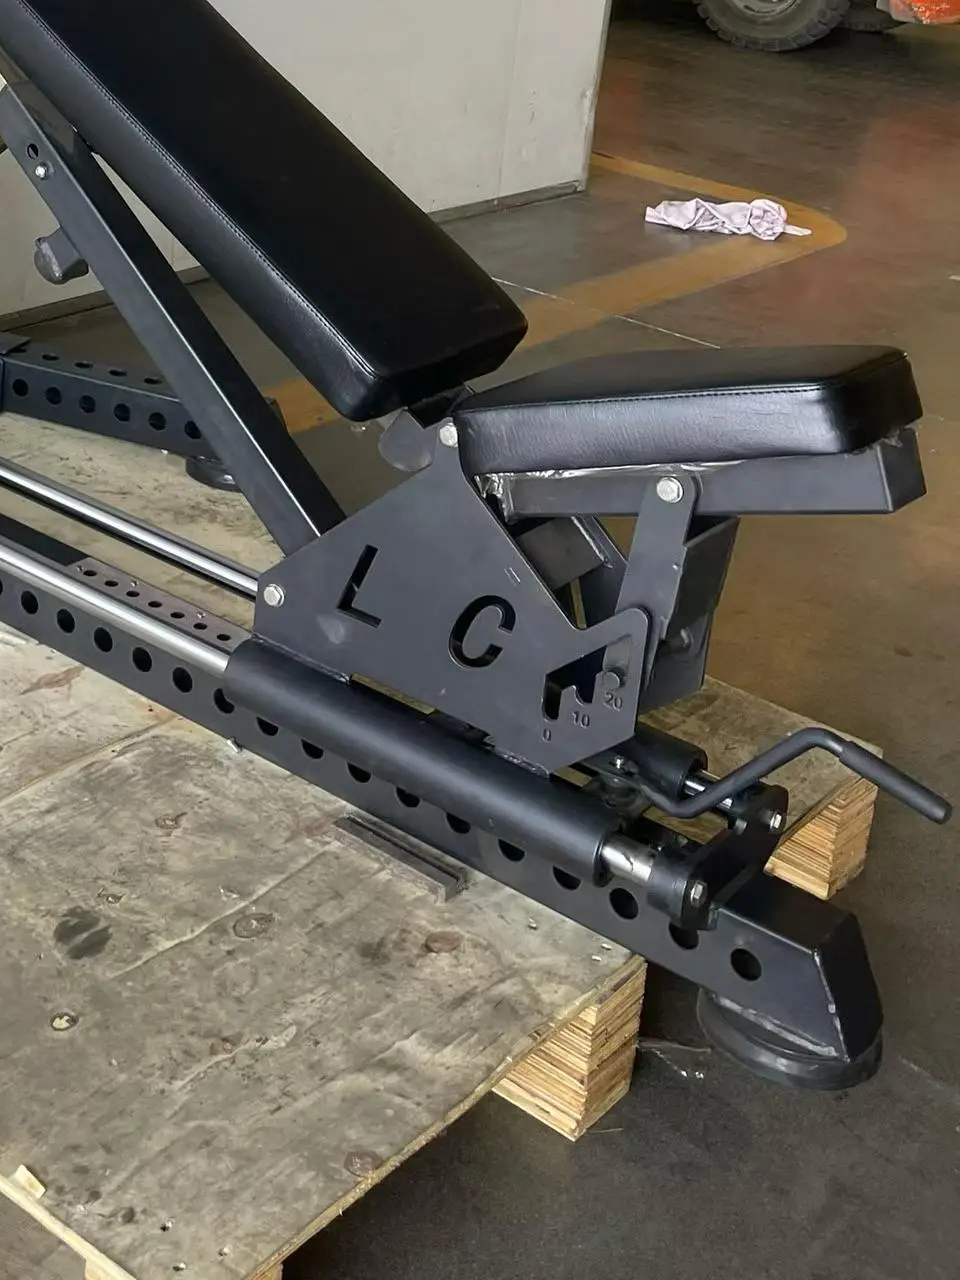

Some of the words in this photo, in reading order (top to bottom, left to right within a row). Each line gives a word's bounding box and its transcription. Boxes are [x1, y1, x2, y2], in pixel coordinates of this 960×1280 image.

[542, 727, 552, 742] 0
[571, 710, 591, 729] 10
[604, 692, 624, 712] 20
